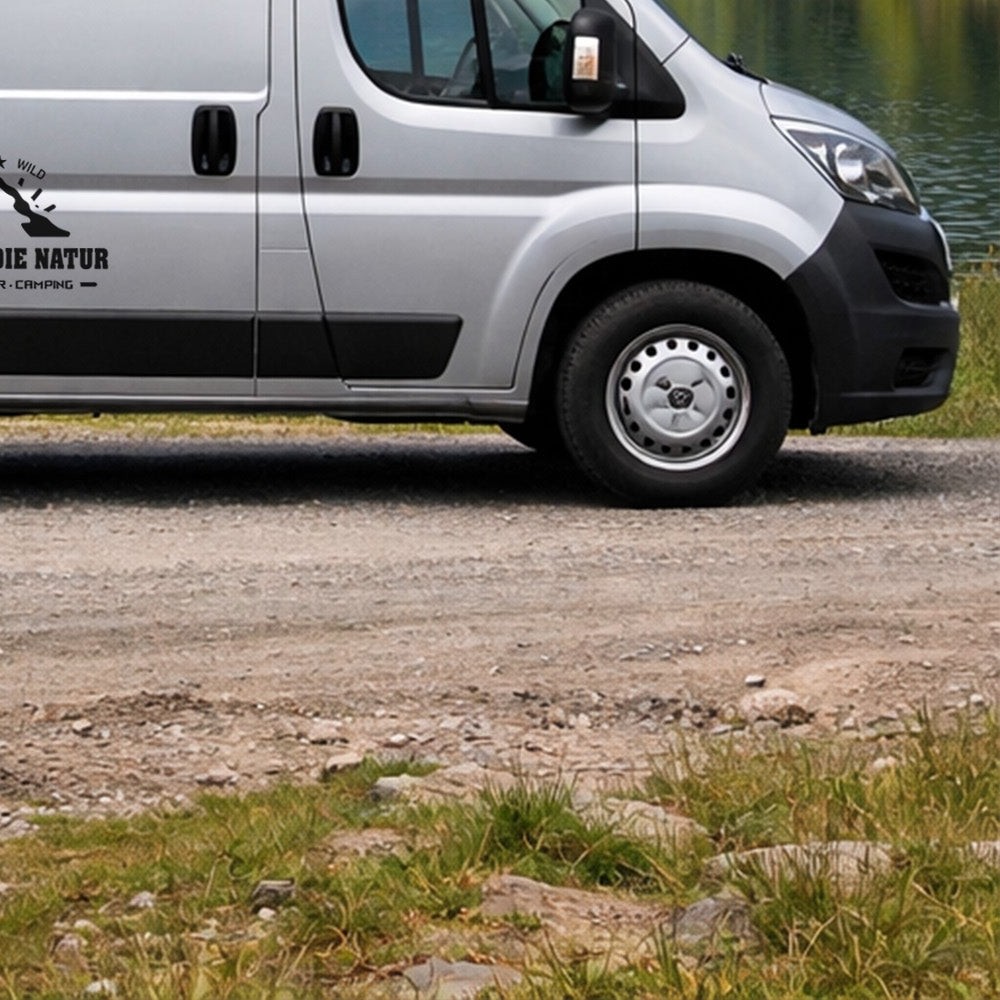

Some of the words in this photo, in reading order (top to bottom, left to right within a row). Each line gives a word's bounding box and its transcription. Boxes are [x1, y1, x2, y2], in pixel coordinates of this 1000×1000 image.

[16, 158, 47, 180] WILD
[34, 247, 109, 269] NATUR
[15, 279, 74, 290] CAMPING
